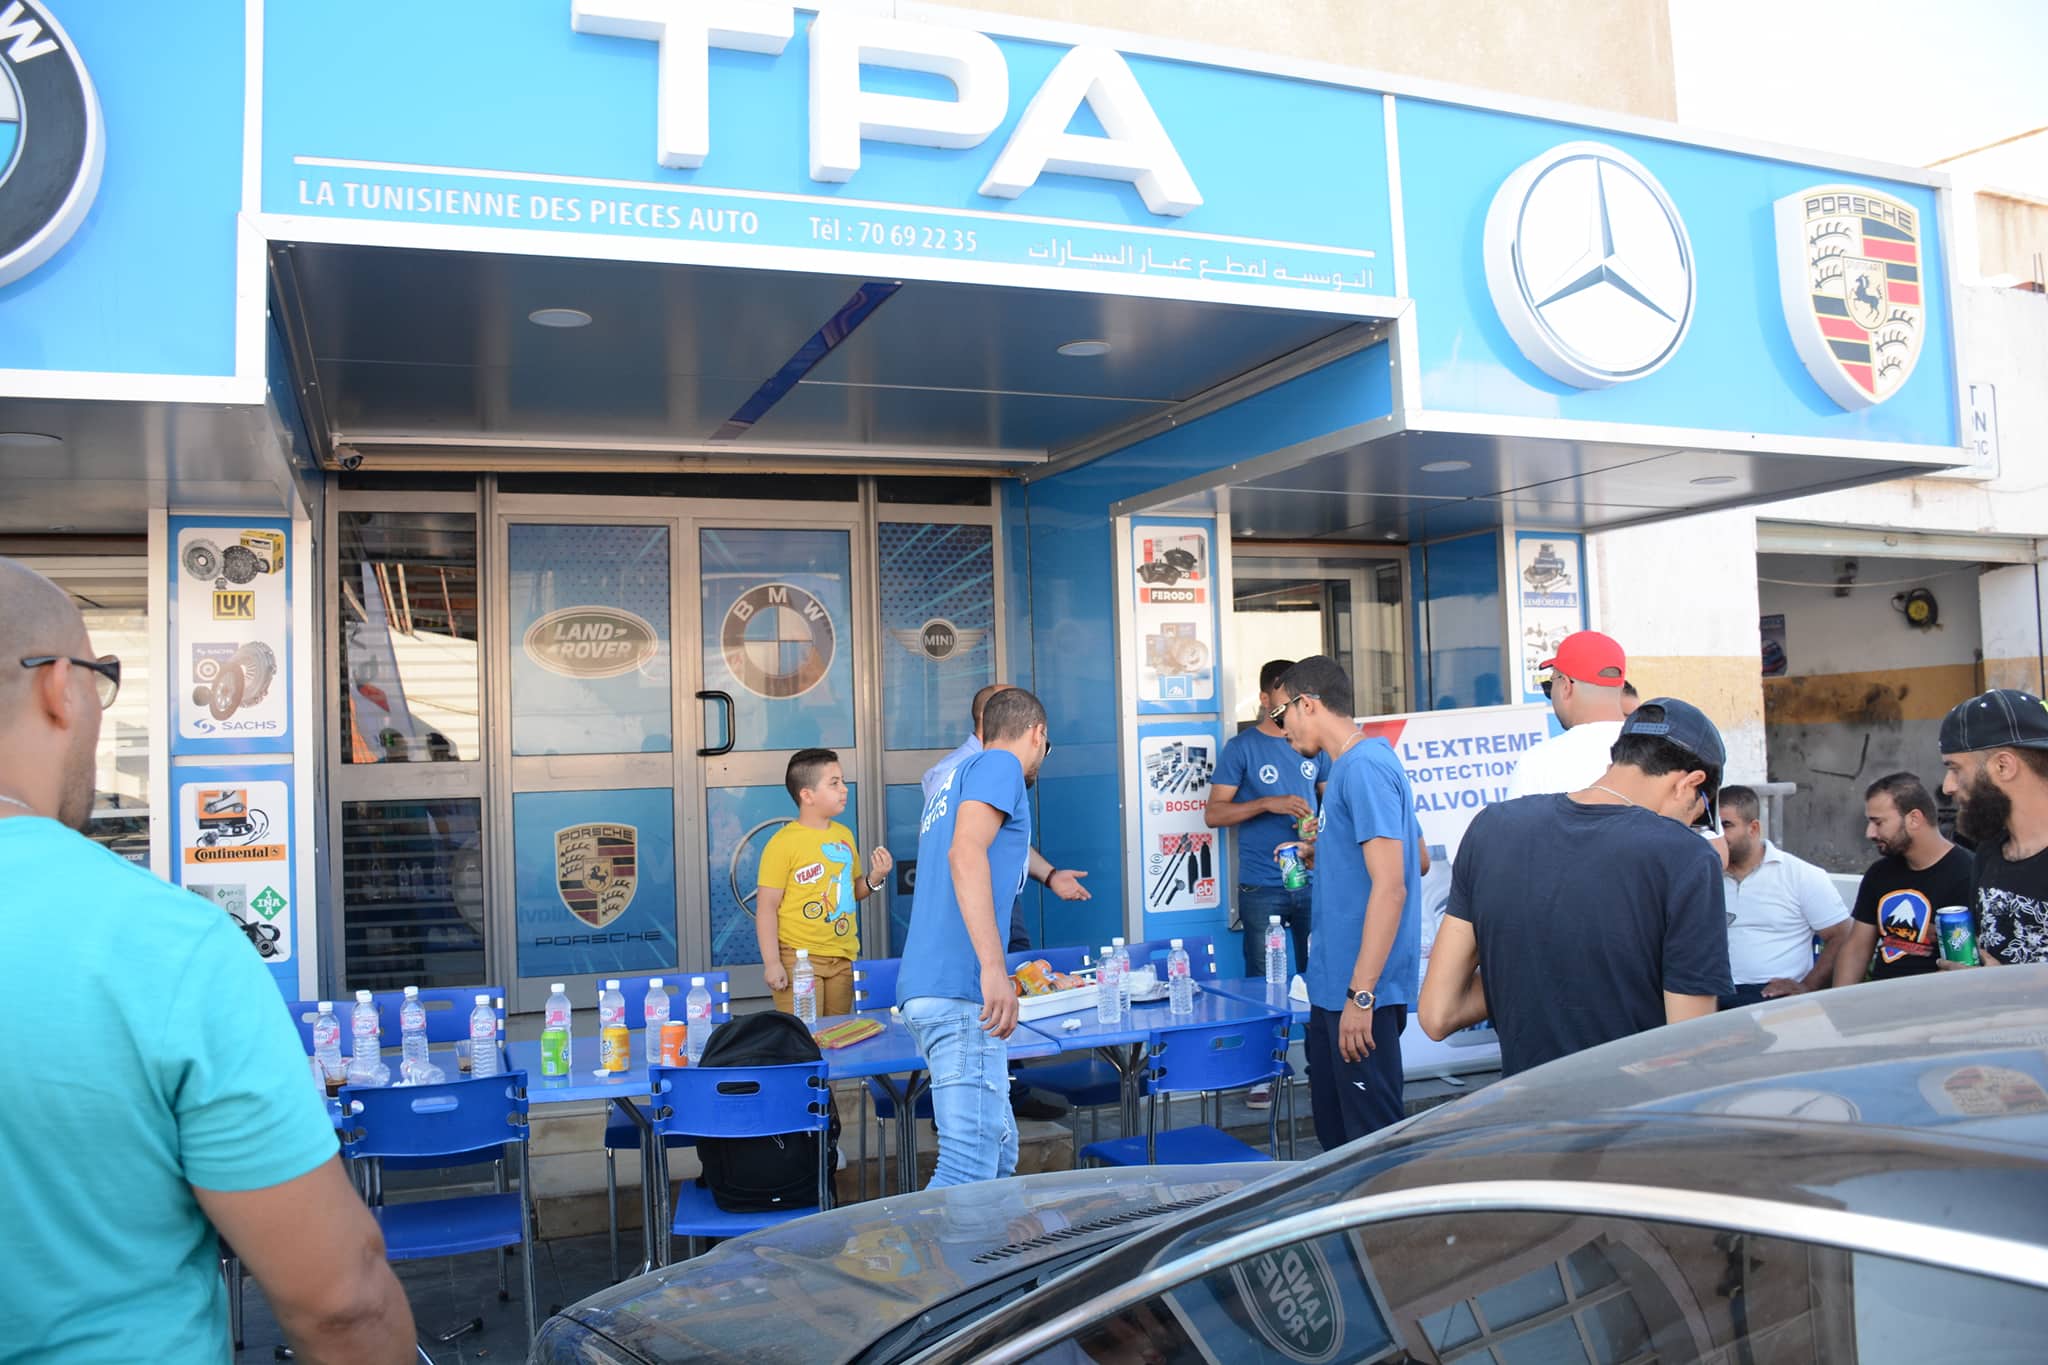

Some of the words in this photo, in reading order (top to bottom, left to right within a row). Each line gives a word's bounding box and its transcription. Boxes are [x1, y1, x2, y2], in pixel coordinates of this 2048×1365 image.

[571, 0, 1204, 217] TPA
[298, 180, 335, 207] LA
[343, 182, 521, 218] TUNISIENNE
[529, 196, 582, 223] DES
[590, 200, 682, 230] PIECES
[688, 207, 760, 235] AUTO
[1805, 195, 1913, 231] PORSCHE
[809, 216, 841, 242] Tél
[858, 220, 885, 246] 70
[889, 223, 917, 249] 69
[921, 226, 948, 251] 22
[952, 229, 978, 253] 35
[1028, 237, 1134, 267] السيارات
[733, 587, 825, 622] BMW
[1151, 590, 1194, 601] FERODO
[554, 623, 615, 641] LAND
[924, 634, 954, 646] MINI
[560, 641, 633, 659] ROVER
[221, 719, 277, 731] SACHS
[1402, 731, 1543, 761] L'EXTREME
[1405, 760, 1517, 783] ROTECTION
[1165, 799, 1207, 813] BOSCH
[560, 828, 634, 844] PORSCHE
[194, 846, 269, 863] Continental
[535, 930, 663, 947] PORSCHE
